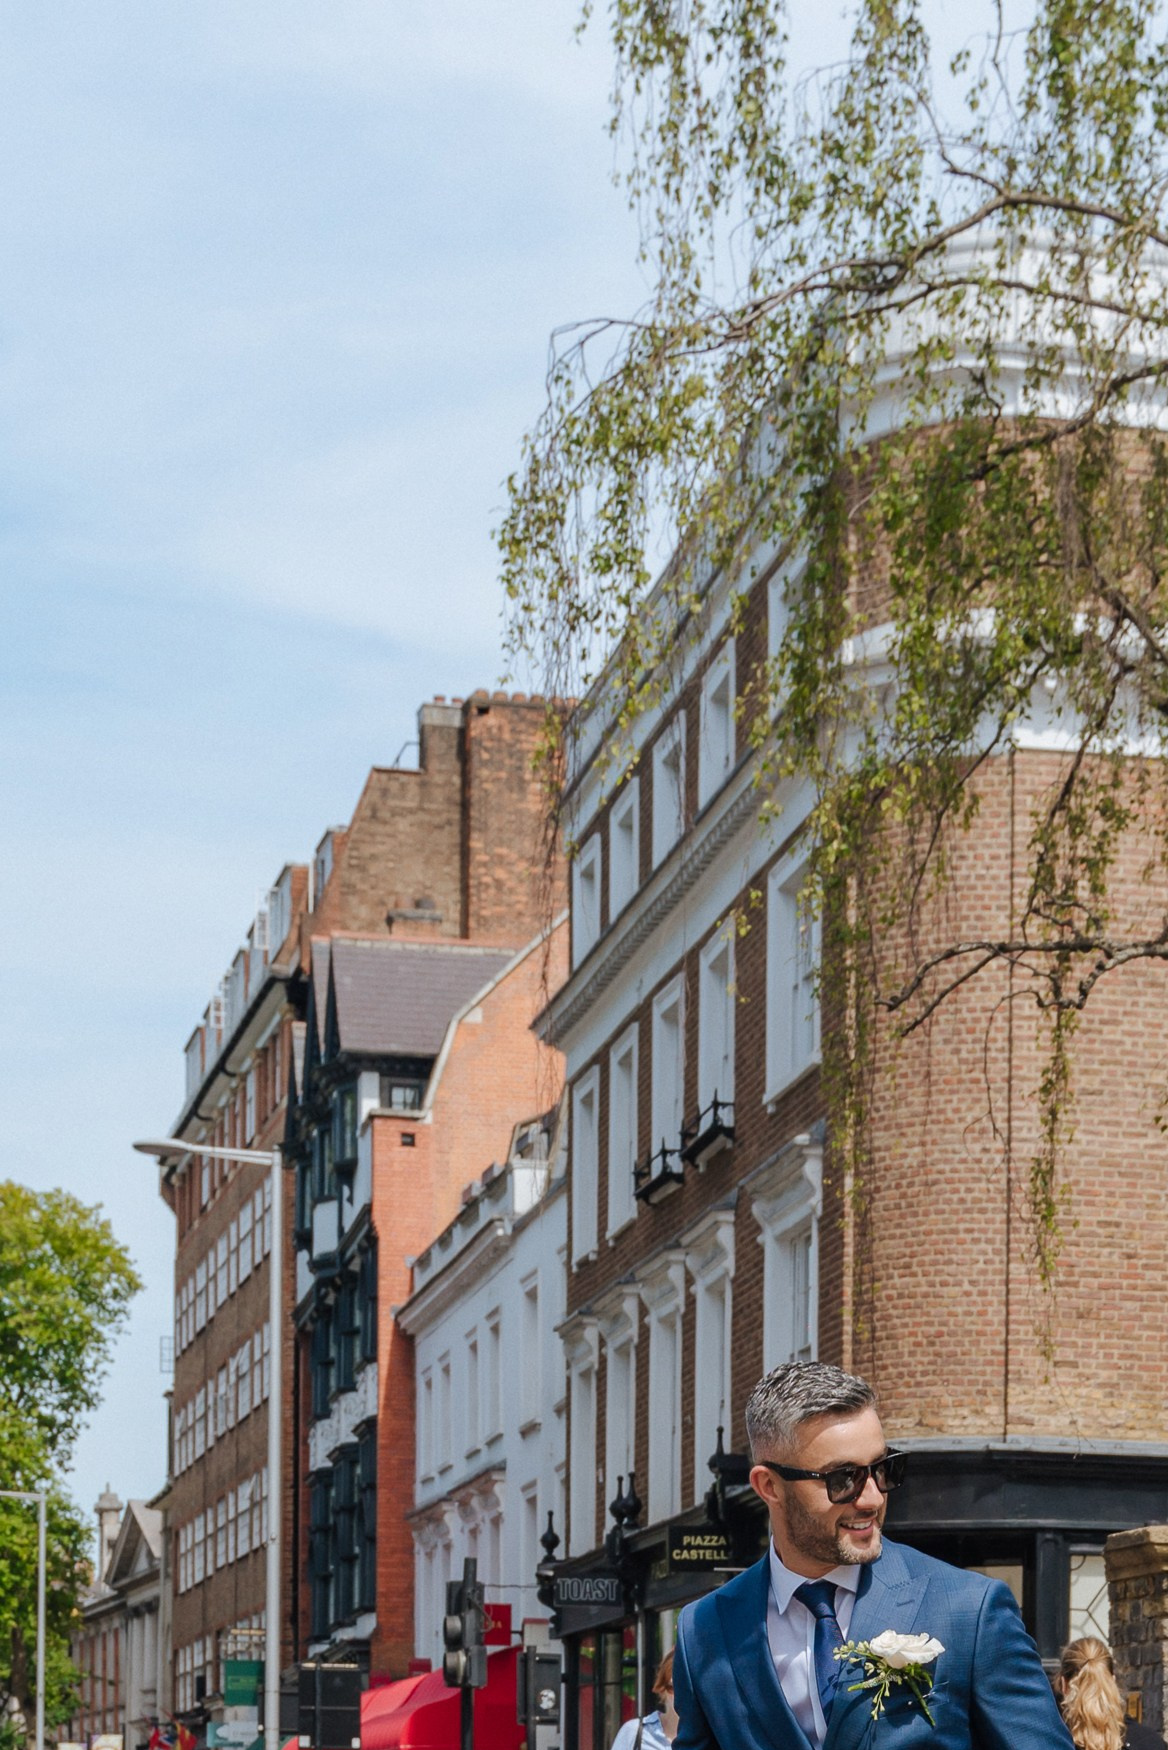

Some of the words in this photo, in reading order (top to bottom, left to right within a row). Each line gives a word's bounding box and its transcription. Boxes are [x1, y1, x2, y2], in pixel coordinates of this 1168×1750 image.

[682, 1535, 727, 1546] PIAZZA
[672, 1549, 730, 1560] CASTELL
[557, 1577, 618, 1601] TOAST
